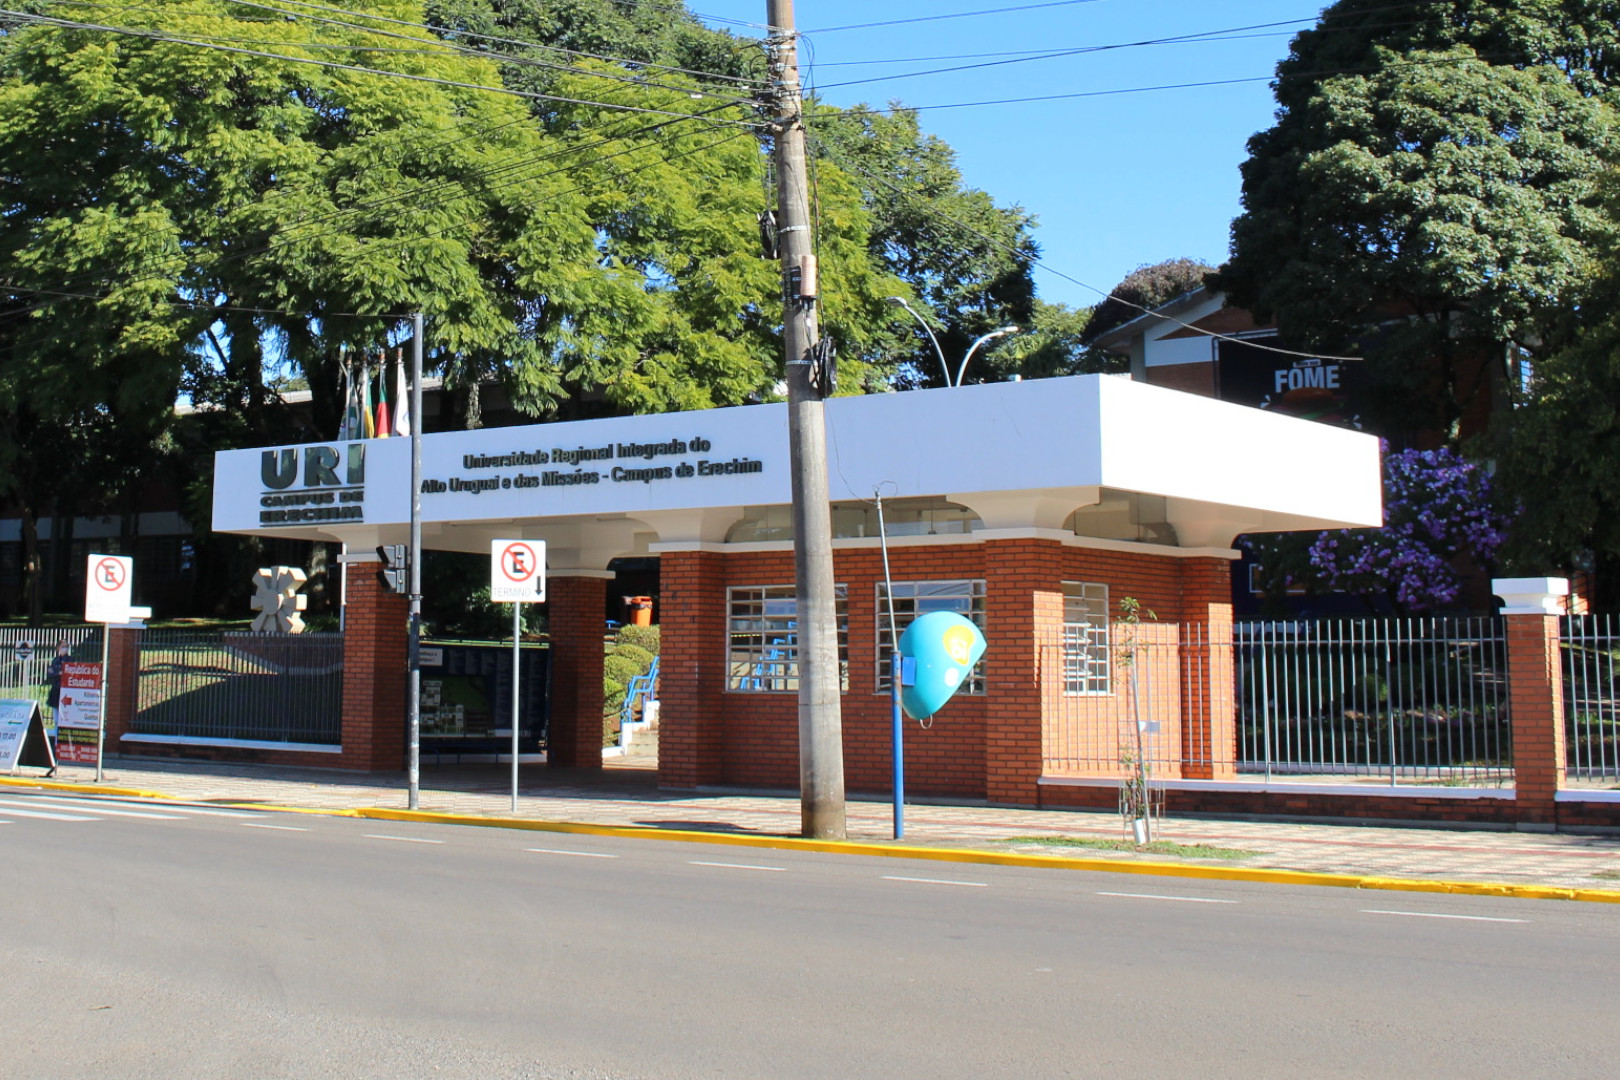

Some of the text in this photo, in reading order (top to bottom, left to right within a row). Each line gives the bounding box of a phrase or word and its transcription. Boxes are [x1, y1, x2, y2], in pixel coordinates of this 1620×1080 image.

[1274, 365, 1340, 393] FOME
[463, 437, 711, 469] Universidade Regional Integrada do
[261, 443, 366, 489] URI
[421, 479, 447, 493] Alto
[449, 475, 500, 494] Uruguai
[501, 477, 511, 489] e
[513, 474, 539, 489] das
[611, 466, 672, 483] Campus
[674, 462, 694, 478] de
[697, 458, 763, 476] Erechim
[260, 491, 364, 507] CAMPUS DE
[260, 506, 363, 523] ERECHIM
[512, 551, 525, 573] E
[92, 666, 99, 675] do
[68, 677, 94, 687] Estudante
